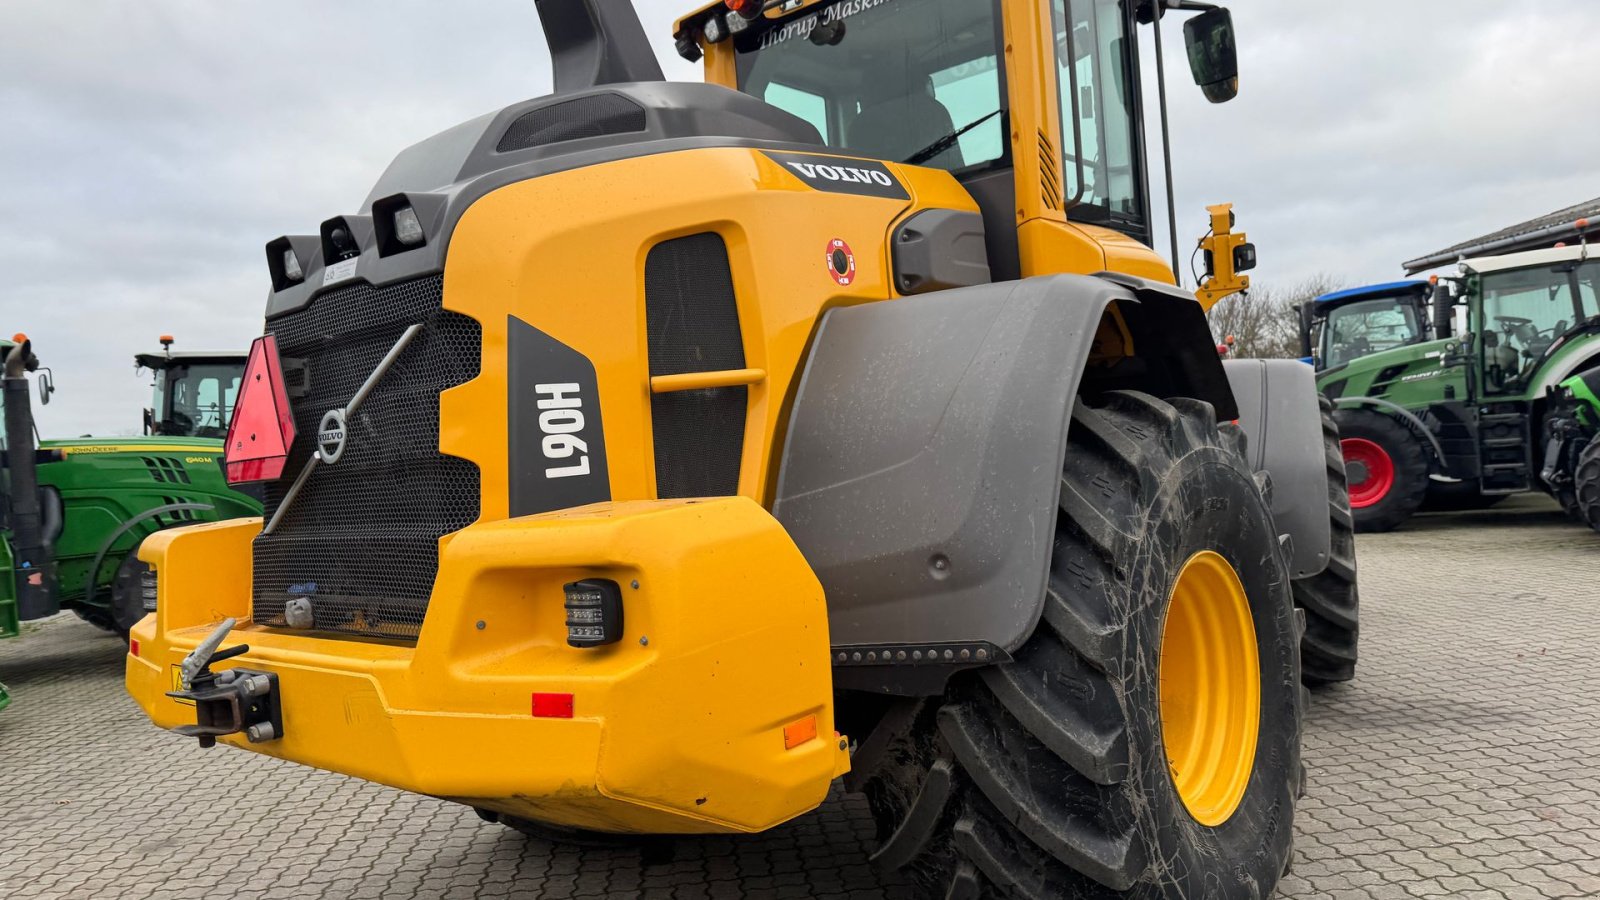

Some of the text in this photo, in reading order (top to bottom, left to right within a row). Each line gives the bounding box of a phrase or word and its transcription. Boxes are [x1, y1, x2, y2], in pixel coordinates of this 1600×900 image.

[758, 0, 890, 50] Thorup Mask
[786, 161, 893, 187] VOLVO
[318, 431, 344, 442] VOLVO
[535, 382, 591, 479] L90H
[72, 446, 92, 454] JOHN
